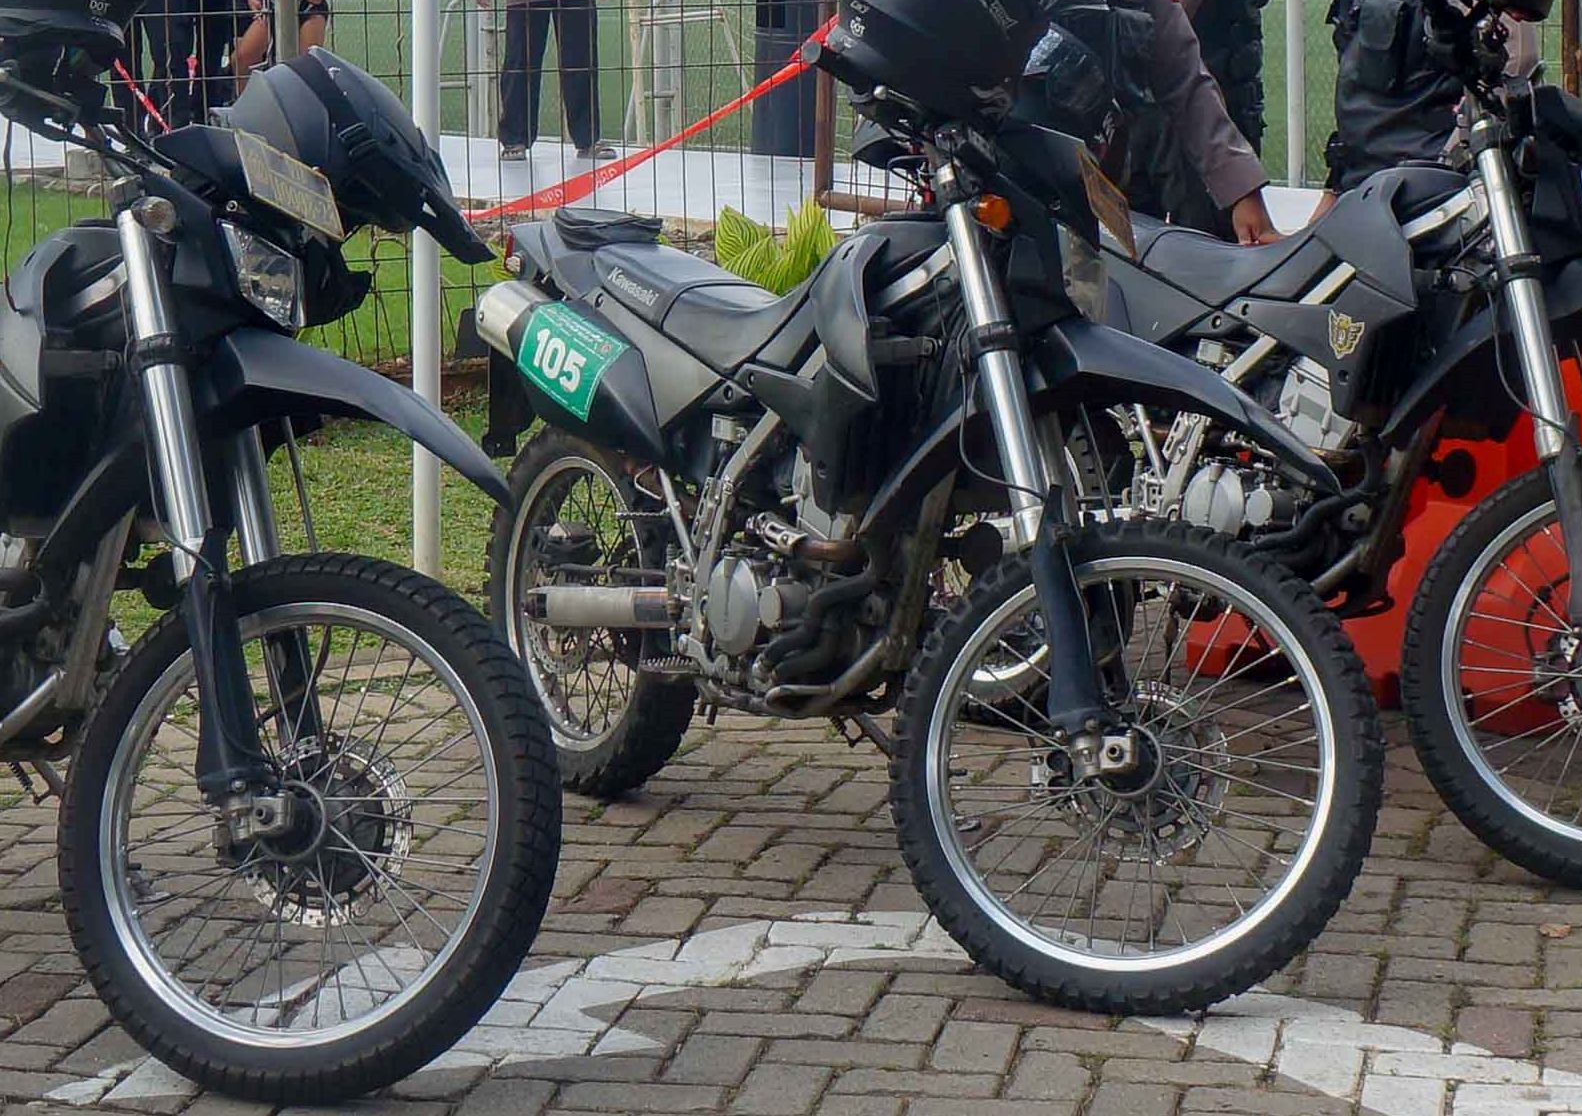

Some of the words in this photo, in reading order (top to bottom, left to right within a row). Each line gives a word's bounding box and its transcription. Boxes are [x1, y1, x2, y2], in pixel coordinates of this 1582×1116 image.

[89, 0, 110, 12] DOT
[607, 266, 660, 307] Kawasaki
[533, 328, 586, 393] 105
